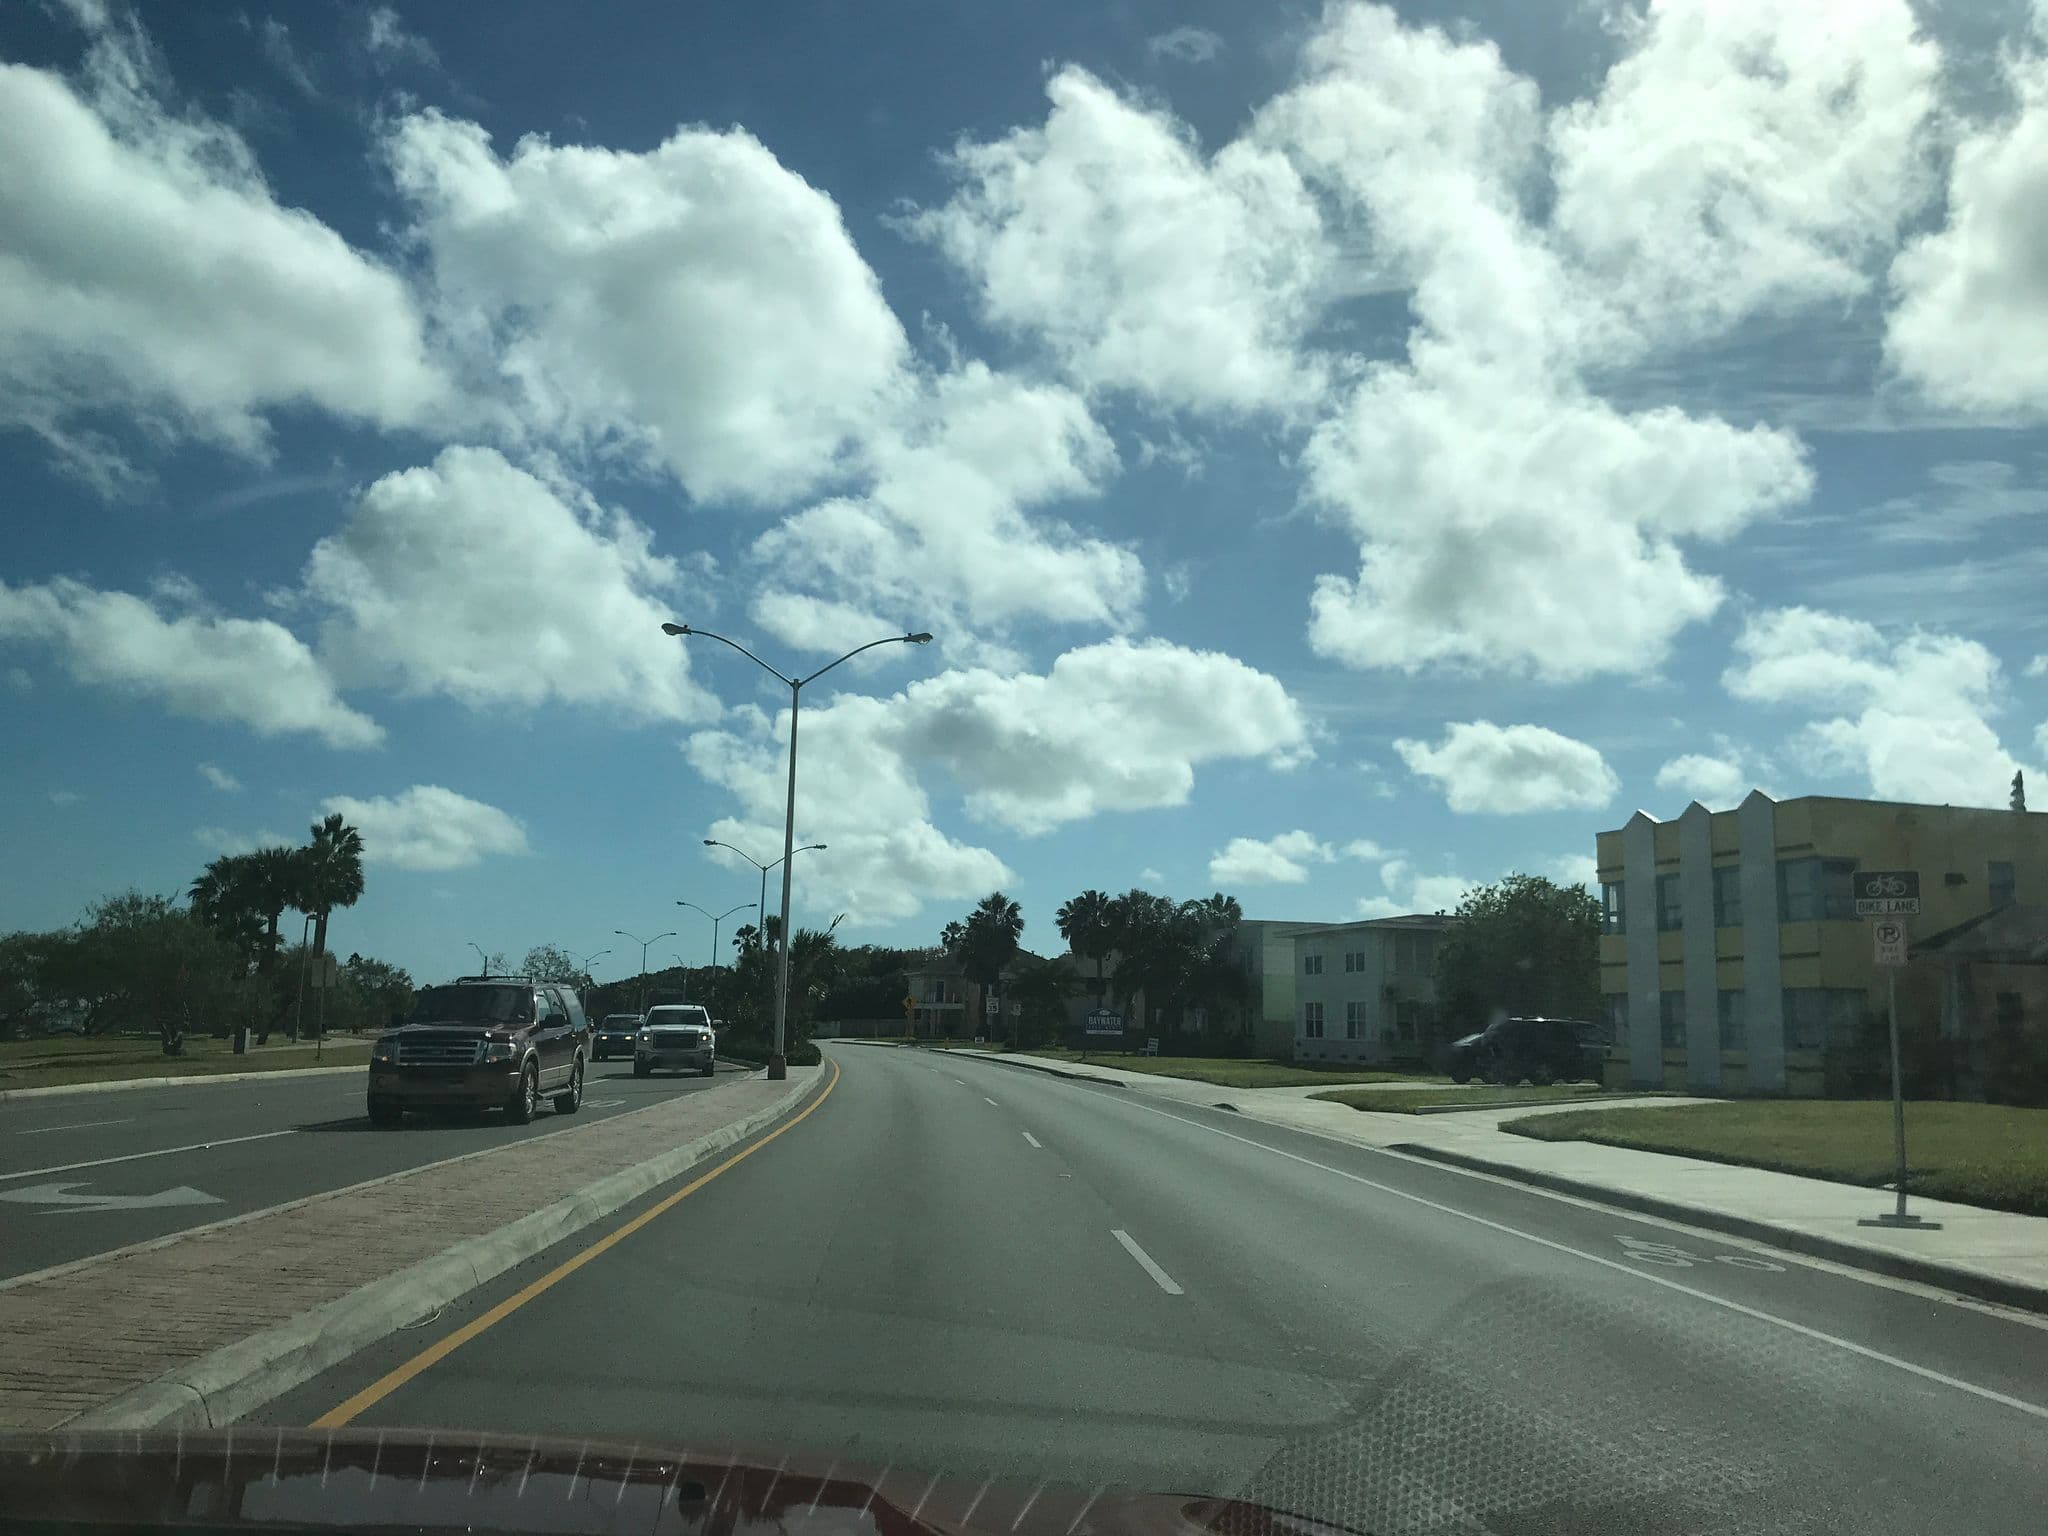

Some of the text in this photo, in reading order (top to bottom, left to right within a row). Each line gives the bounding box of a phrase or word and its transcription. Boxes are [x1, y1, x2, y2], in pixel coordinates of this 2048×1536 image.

[1858, 900, 1916, 913] BIKE LANE
[1088, 1016, 1121, 1025] BAYWATER
